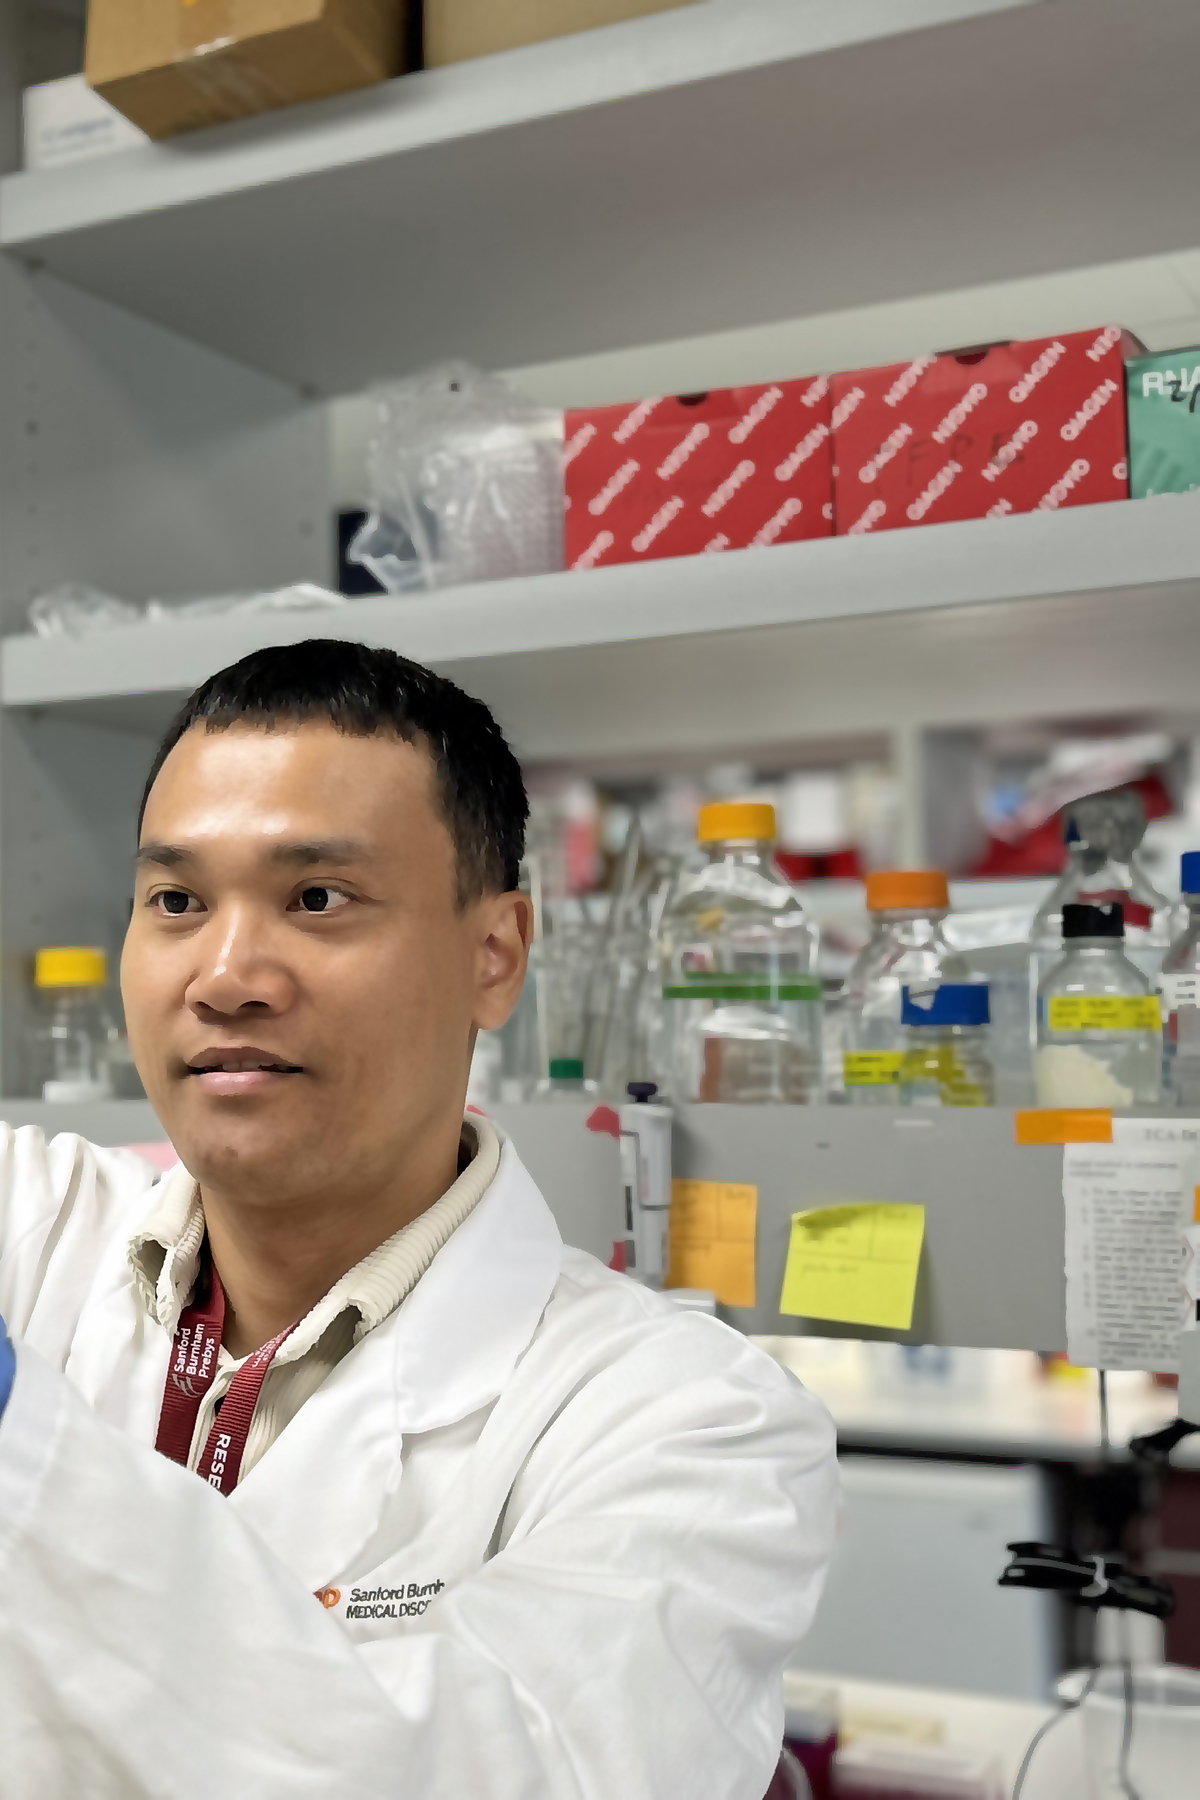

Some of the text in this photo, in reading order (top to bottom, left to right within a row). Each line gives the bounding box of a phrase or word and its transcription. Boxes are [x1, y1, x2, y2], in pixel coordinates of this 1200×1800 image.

[174, 1328, 191, 1373] Sanford
[186, 1323, 205, 1376] Burnham
[198, 1338, 215, 1379] Prebys
[208, 1433, 232, 1490] RESE
[345, 1604, 398, 1619] MEDICAL
[349, 1584, 405, 1603] Sanford
